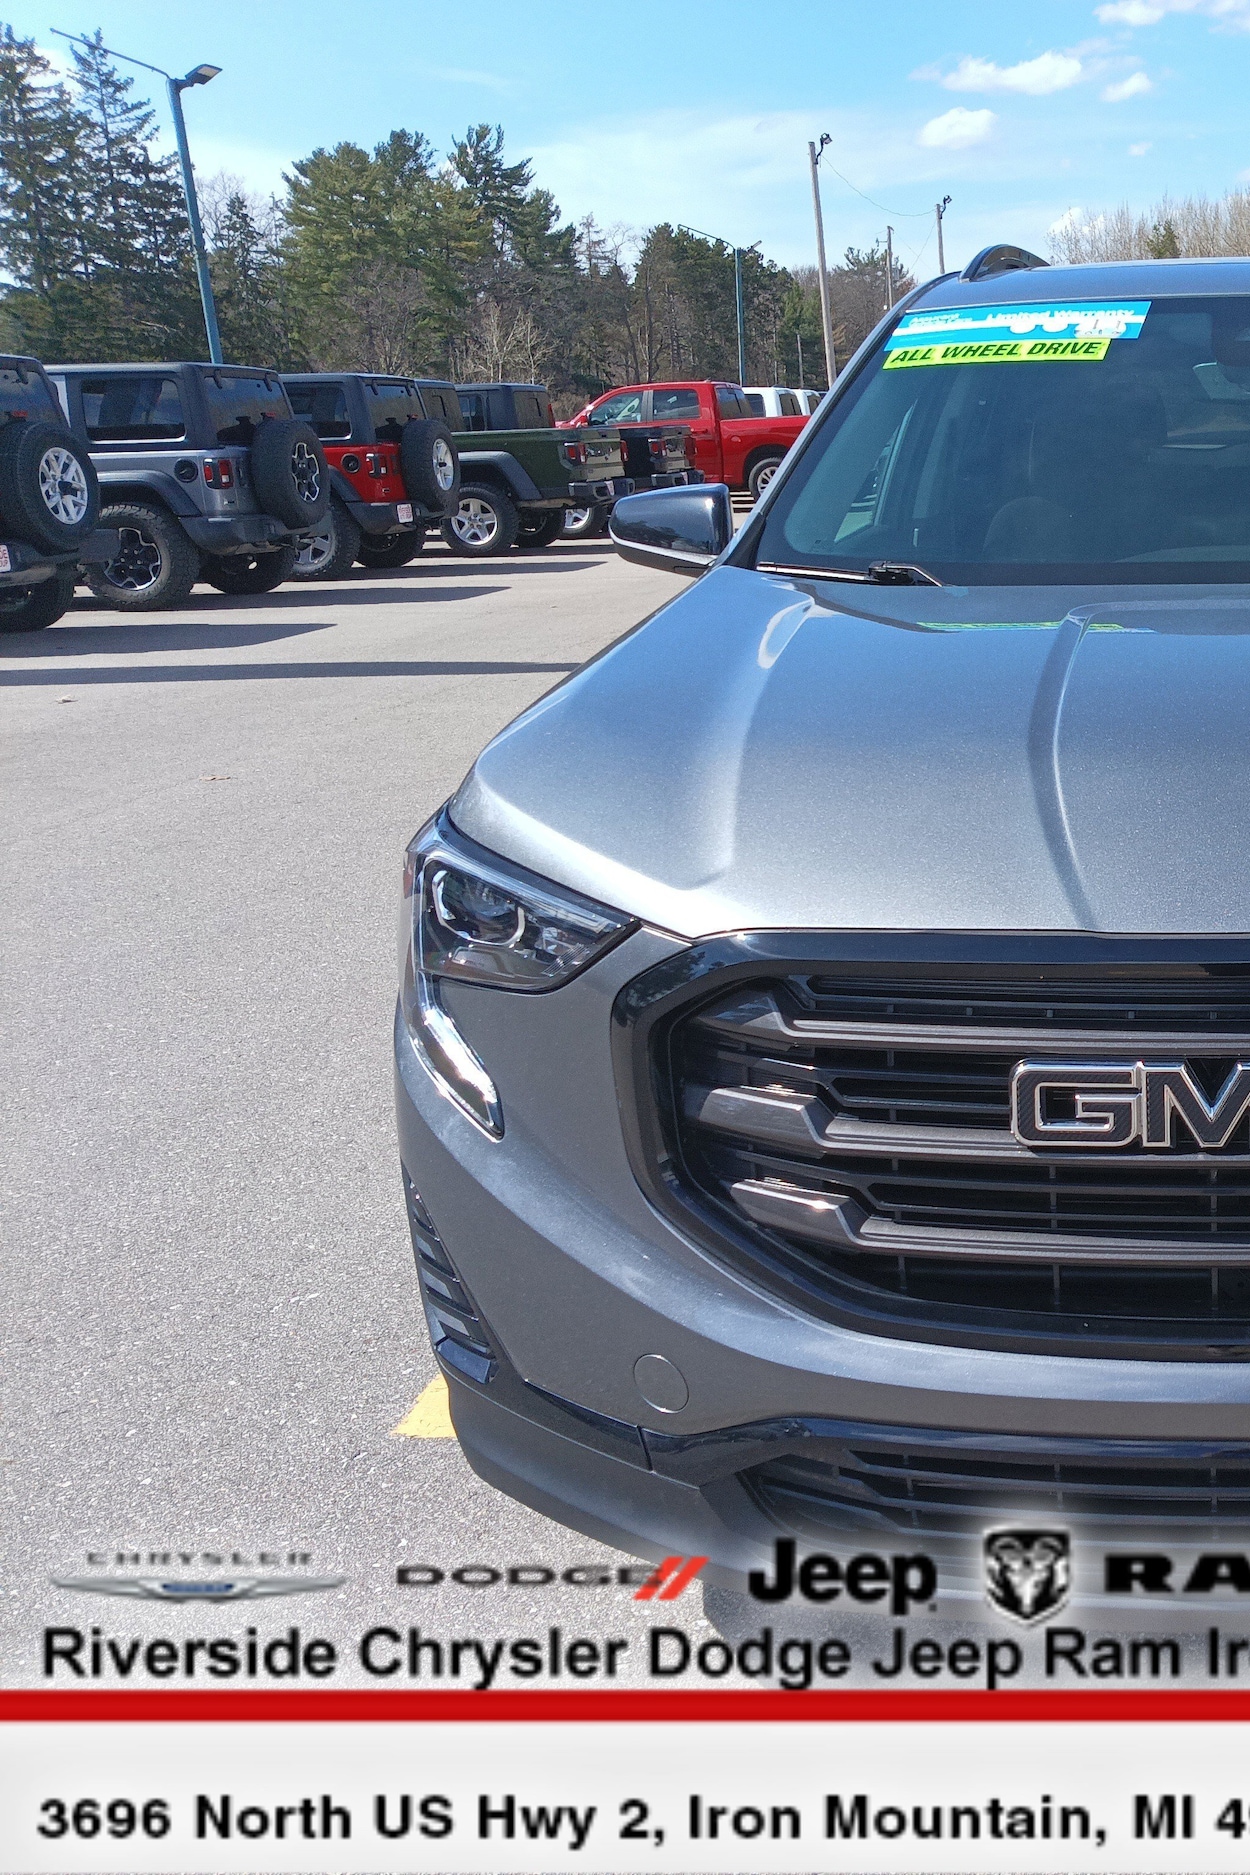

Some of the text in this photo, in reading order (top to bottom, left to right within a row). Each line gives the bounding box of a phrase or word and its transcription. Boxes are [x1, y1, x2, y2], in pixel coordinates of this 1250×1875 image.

[891, 341, 1102, 363] ALL WHEEL DRIVE
